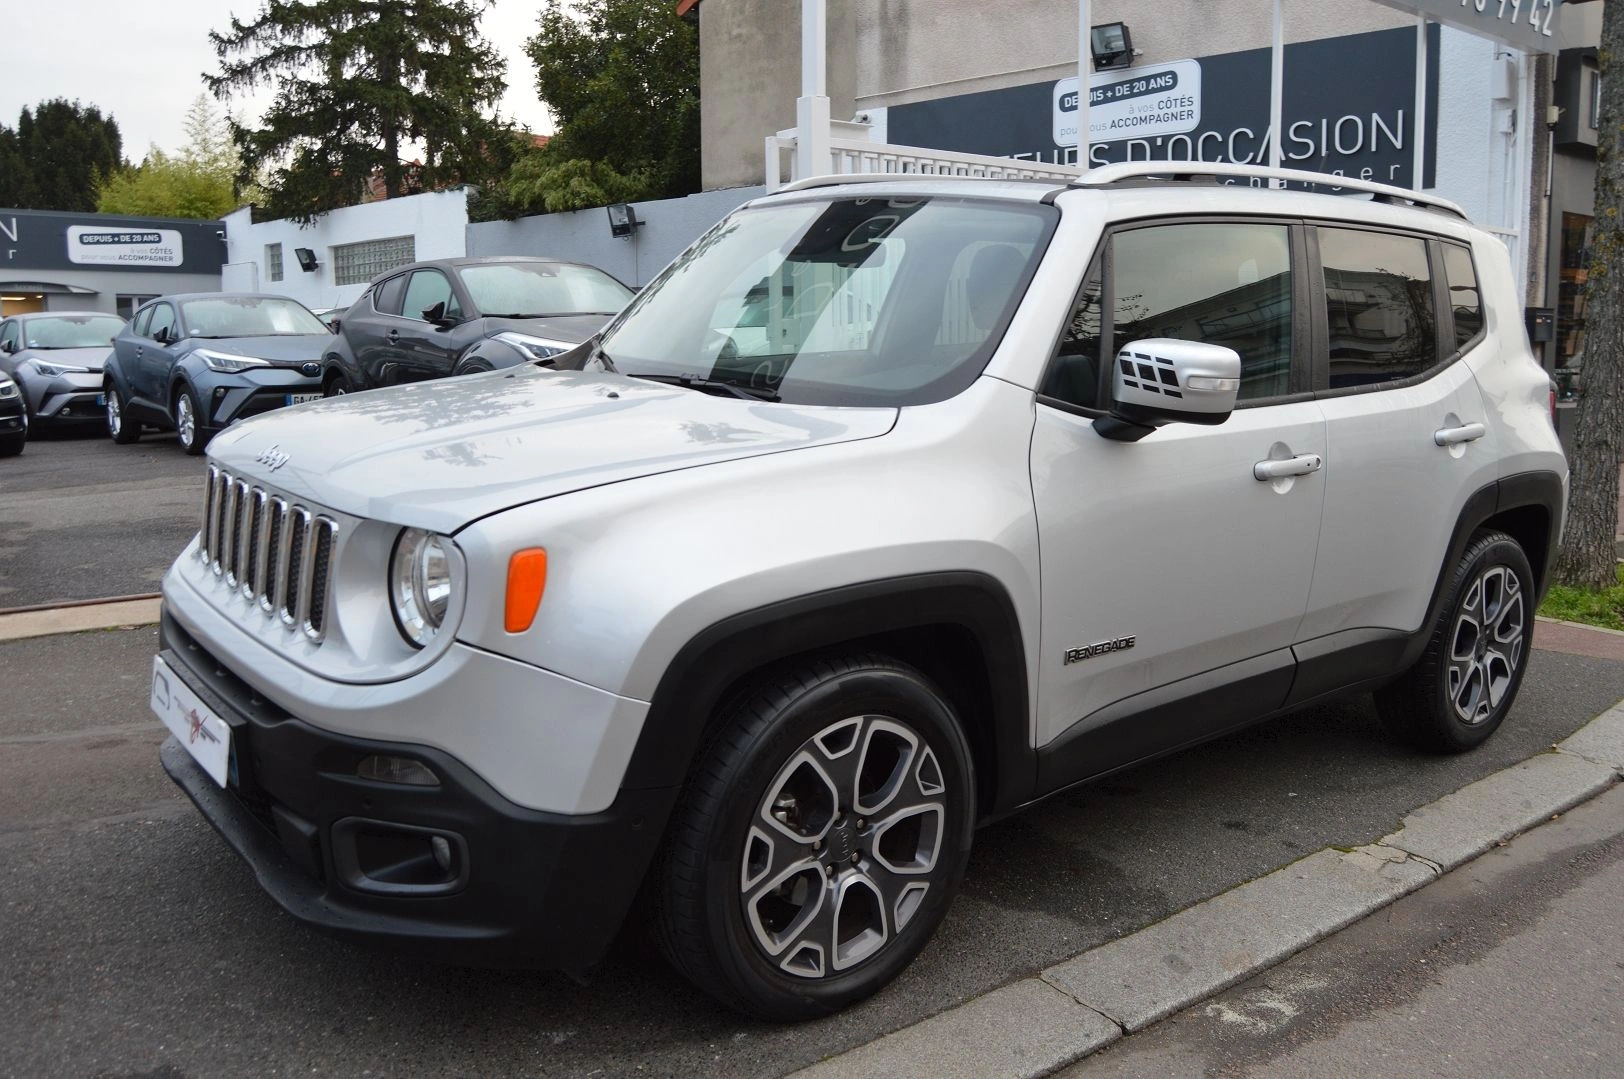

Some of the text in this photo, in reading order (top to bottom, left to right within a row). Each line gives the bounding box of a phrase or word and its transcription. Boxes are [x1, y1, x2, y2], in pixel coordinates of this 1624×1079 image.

[1064, 90, 1104, 108] DEUIS
[1115, 84, 1131, 97] DE
[1133, 81, 1147, 93] 20
[1149, 75, 1174, 90] ANS
[1128, 94, 1194, 114] à vos CÔTÉS
[1060, 110, 1194, 137] pou ous ACCOMPAGNER
[1127, 109, 1404, 164] D'OCCASION
[82, 235, 113, 243] DEPUIS
[143, 234, 159, 242] ANS
[118, 254, 174, 262] ACCOMPAGNER
[256, 444, 290, 473] Jeep
[1064, 635, 1136, 666] RENEGADE
